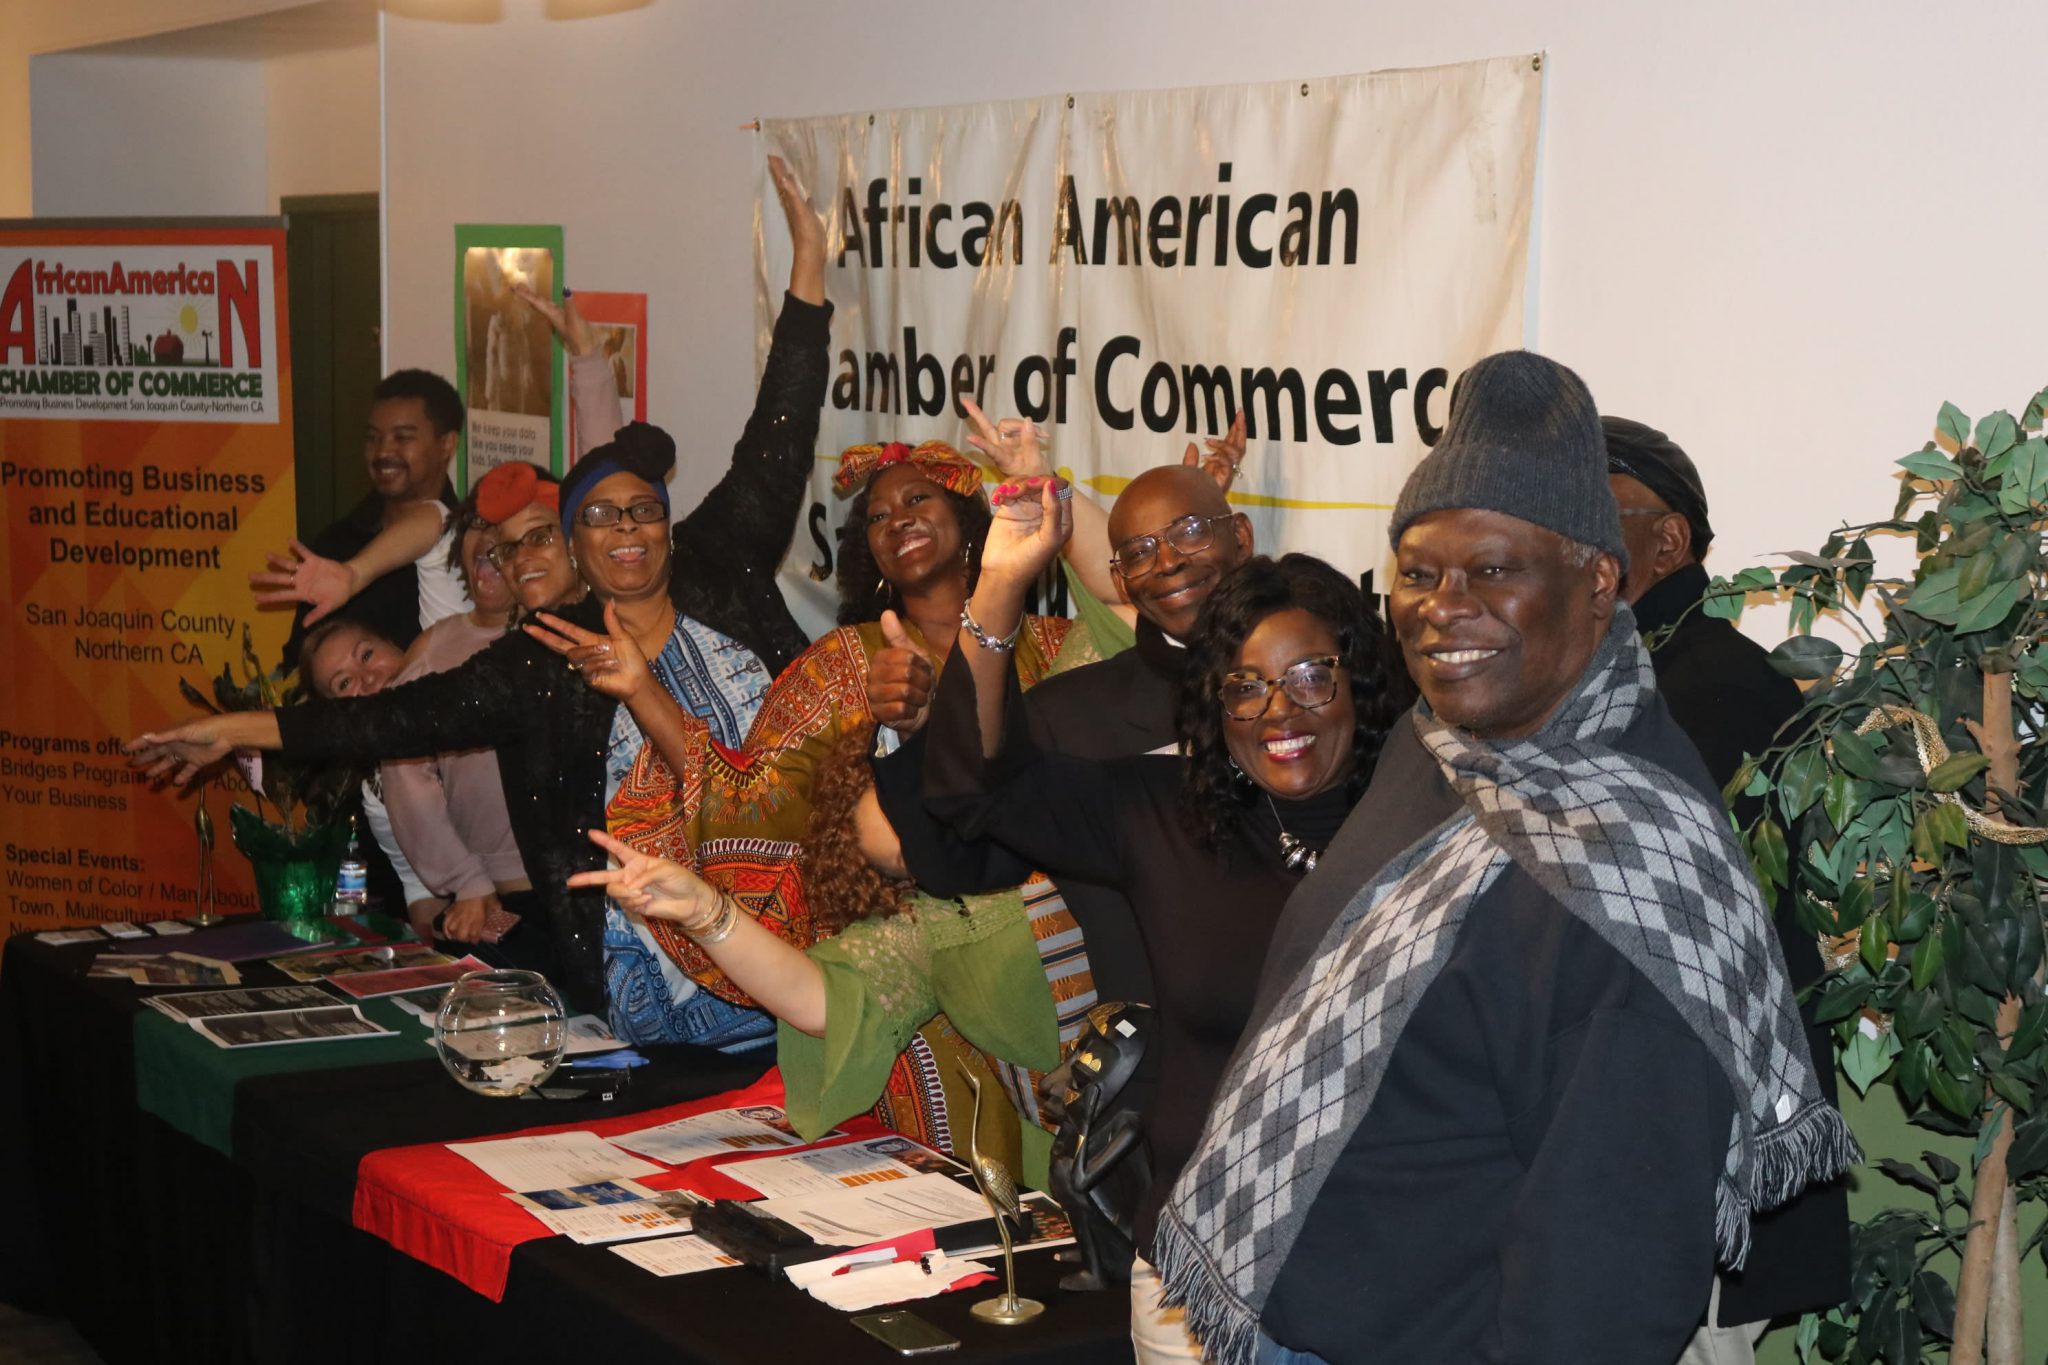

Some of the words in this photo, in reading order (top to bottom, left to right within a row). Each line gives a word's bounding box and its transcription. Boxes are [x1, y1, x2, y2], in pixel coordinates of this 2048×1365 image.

[837, 176, 1024, 270] African
[1049, 161, 1361, 268] American
[0, 369, 101, 395] CHAMBER
[105, 372, 134, 396] OF
[139, 373, 263, 398] COMMERCE
[831, 326, 996, 417] amber
[1013, 326, 1077, 424] of
[1094, 334, 1469, 447] Commerc
[0, 397, 41, 411] Promoting
[42, 398, 75, 410] Business
[75, 398, 128, 412] Development
[130, 399, 145, 411] San
[147, 399, 179, 413] Joaquin
[251, 401, 264, 413] CA
[1, 461, 133, 496] Promoting
[143, 465, 266, 494] Business
[29, 503, 76, 526] and
[85, 502, 239, 531] Educational
[50, 538, 221, 572] Development
[26, 604, 67, 626] San
[74, 607, 153, 634] Joaquin
[161, 609, 235, 640] County
[75, 638, 163, 664] Northern
[171, 642, 204, 665] CA
[0, 731, 90, 755] Programs
[1, 758, 67, 779] Bridges
[2, 785, 43, 805] Your
[49, 788, 128, 811] Business
[6, 844, 72, 868] Special
[78, 849, 145, 872] Events:
[7, 871, 72, 891] Women
[78, 876, 93, 893] of
[98, 877, 143, 898] Color
[160, 884, 198, 903] Man
[10, 896, 59, 918] Town,
[65, 900, 171, 924] Multicultural
